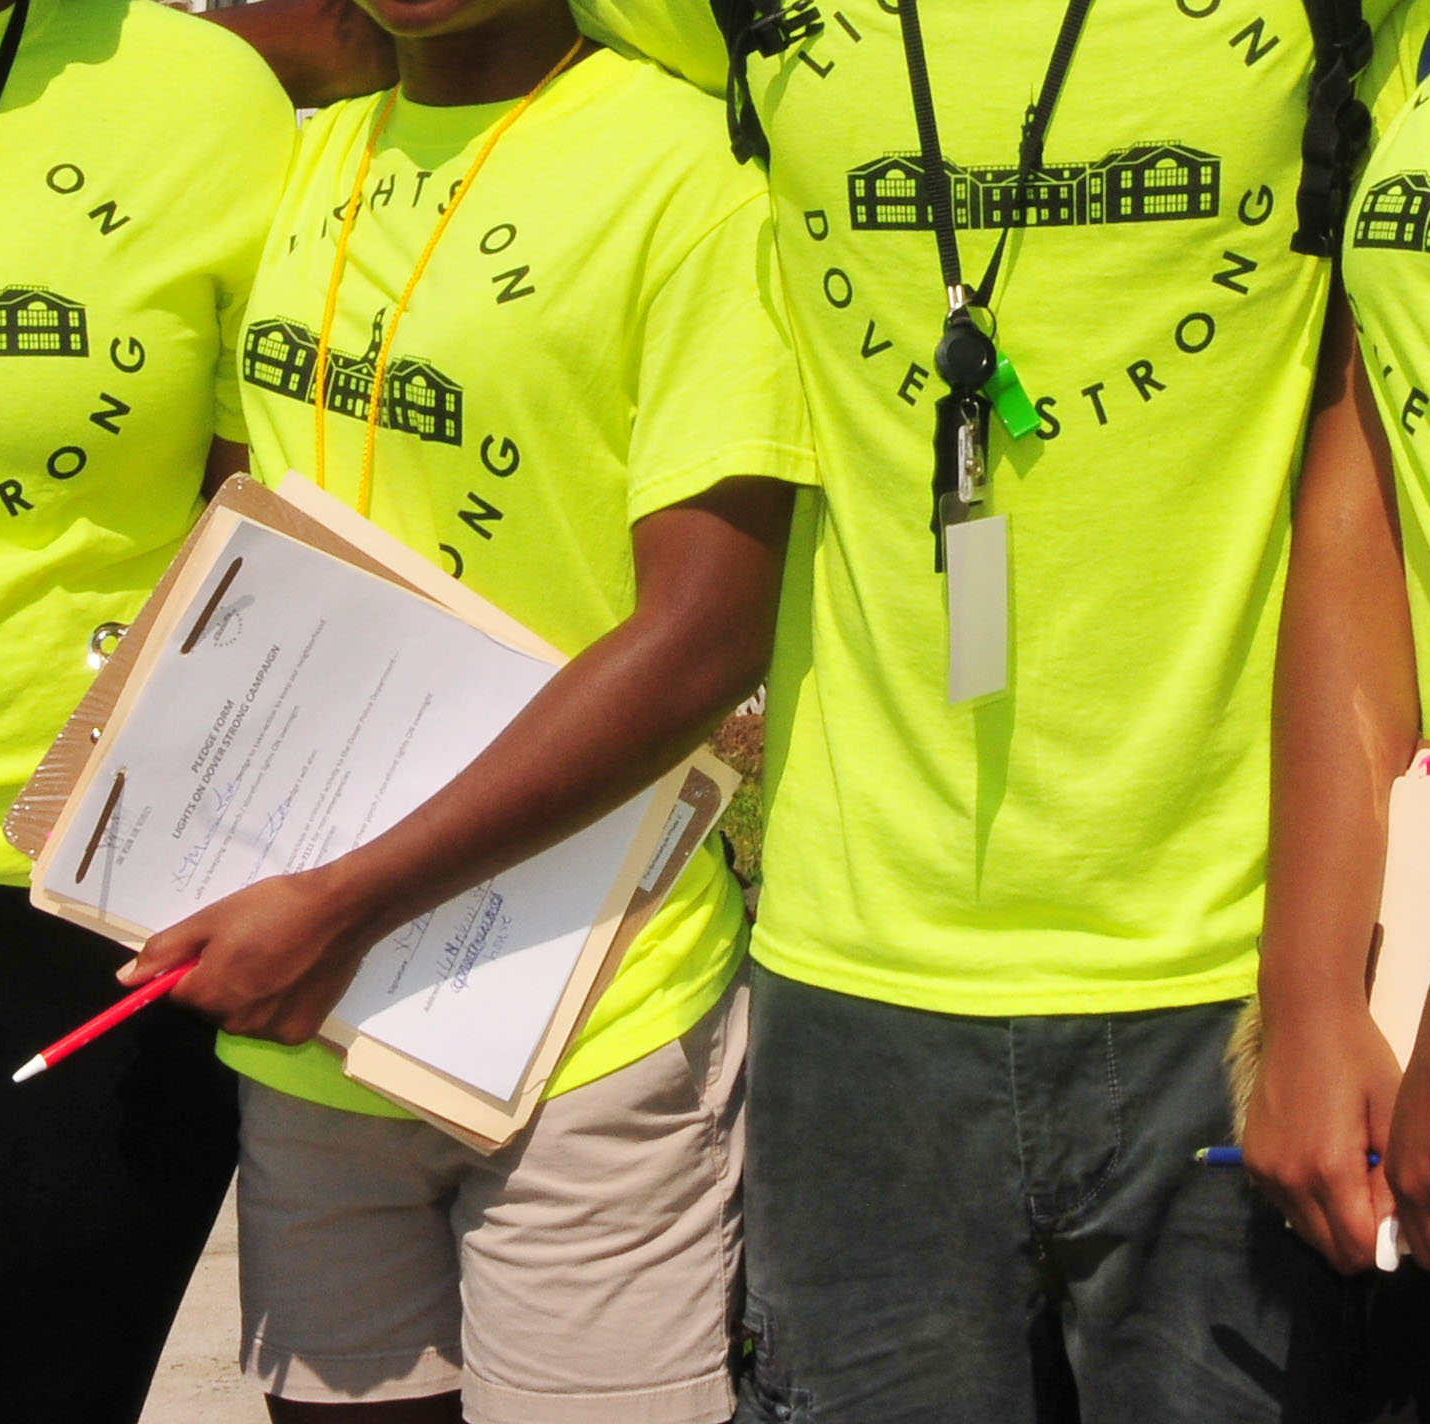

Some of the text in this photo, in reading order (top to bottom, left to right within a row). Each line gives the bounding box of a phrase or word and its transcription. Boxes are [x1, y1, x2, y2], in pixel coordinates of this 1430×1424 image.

[45, 162, 132, 239] ON
[478, 222, 537, 305] ON
[802, 183, 1275, 442] DOVE STRONG
[438, 432, 523, 582] ONG
[170, 642, 282, 840] LIGHTS ON DOVER STRONG CAMPAIGN
[190, 697, 236, 774] PLEDGE FORM
